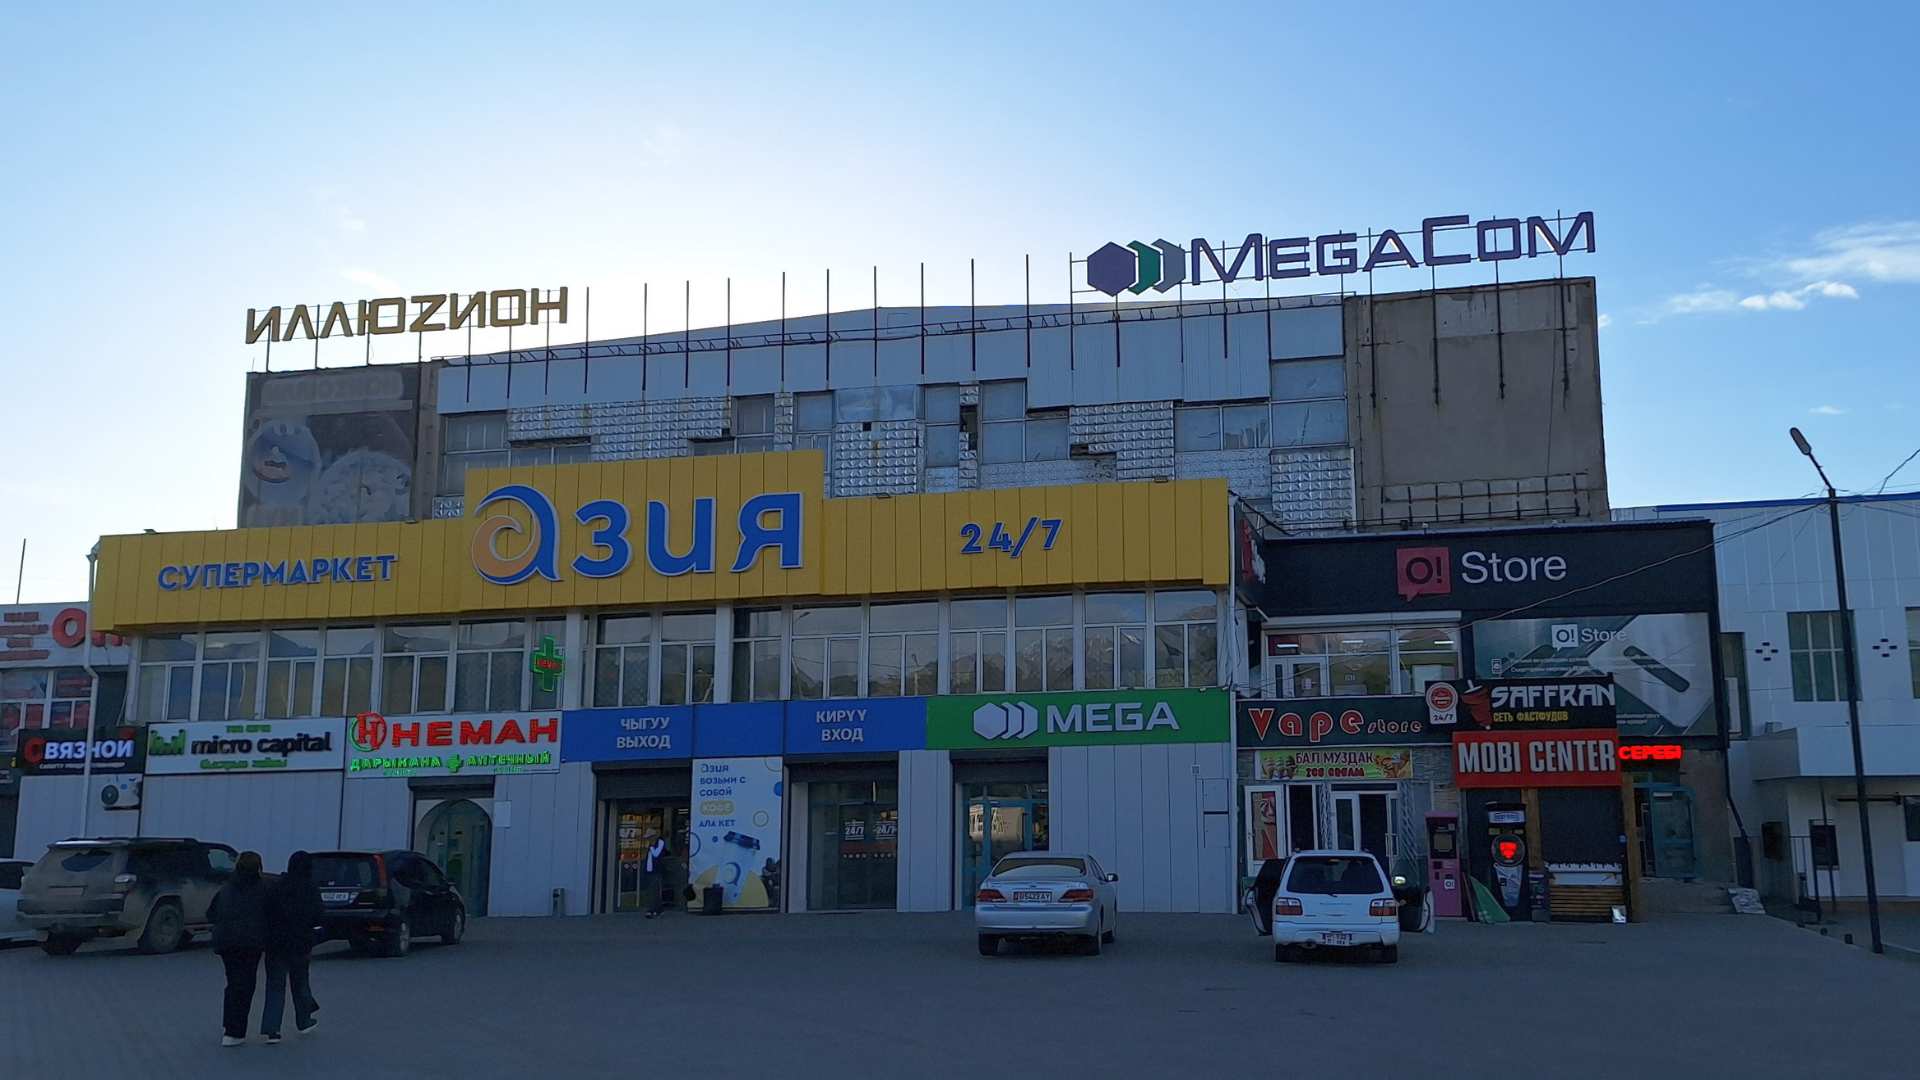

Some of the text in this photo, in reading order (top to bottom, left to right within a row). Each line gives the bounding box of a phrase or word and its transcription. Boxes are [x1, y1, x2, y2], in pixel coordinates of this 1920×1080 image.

[960, 516, 1063, 559] 24/7
[158, 554, 397, 591] СУПЕРМАРКЕТ
[1405, 550, 1568, 585] O! Store
[1556, 628, 1627, 643] O! Store
[1491, 684, 1616, 709] SAFFRAN
[620, 716, 671, 731] ЧЫГУУ
[1047, 702, 1180, 733] MEGA
[1248, 707, 1425, 742] Vape store
[1432, 713, 1454, 721] 24/7
[1493, 710, 1569, 723] СЕТЬ ФАСТФУДОВ
[191, 731, 332, 758] micro capital
[391, 718, 559, 747] НЕМАН
[616, 734, 672, 750] ВЫХОД
[821, 727, 864, 743] ВХОД
[350, 750, 551, 772] ДАРЫКАНА АПТЕЧНЫЙ
[1324, 751, 1375, 766] МУЗДАК
[1457, 739, 1617, 774] MOBI CENTER
